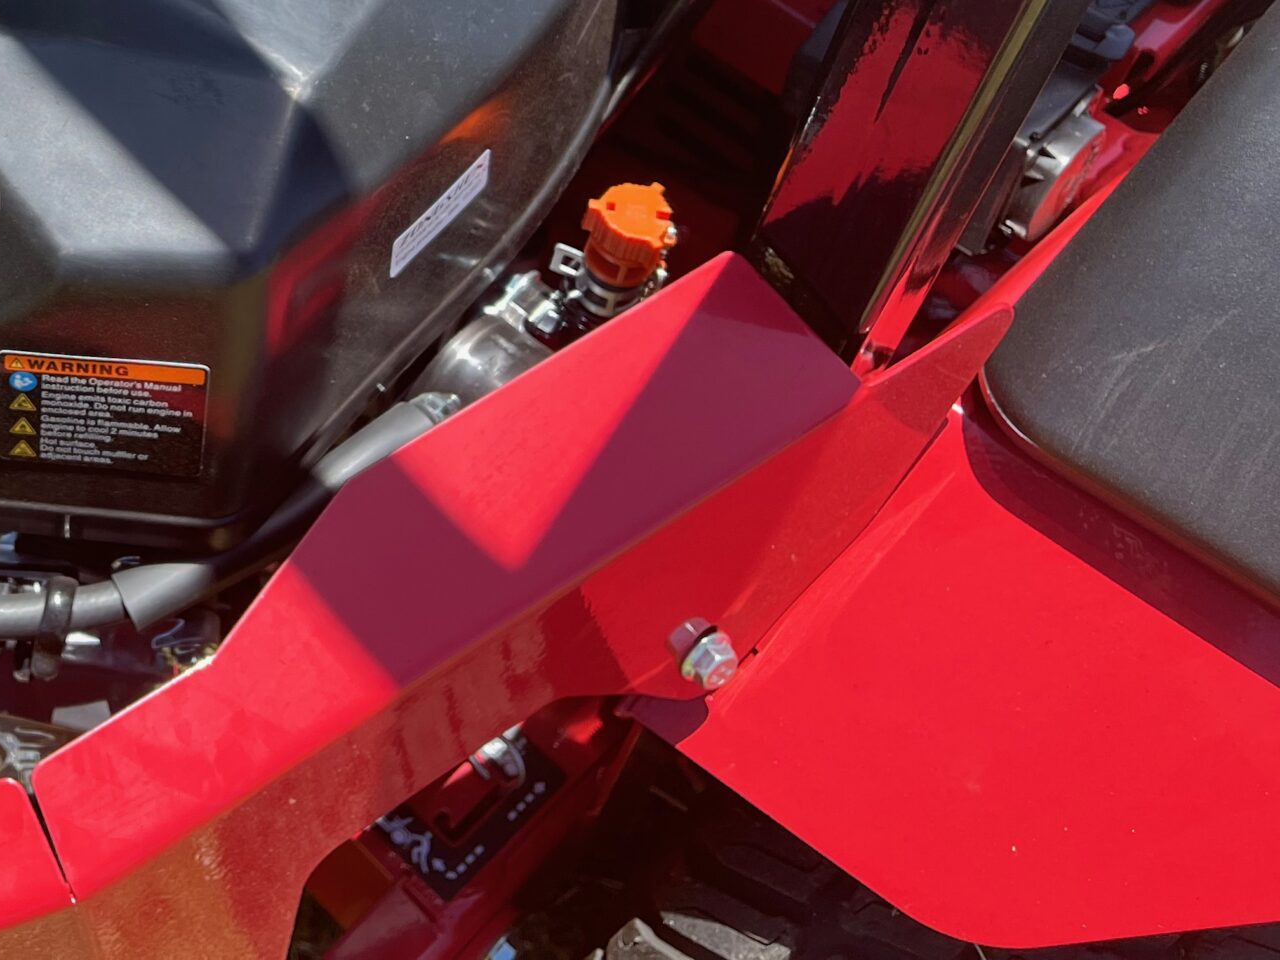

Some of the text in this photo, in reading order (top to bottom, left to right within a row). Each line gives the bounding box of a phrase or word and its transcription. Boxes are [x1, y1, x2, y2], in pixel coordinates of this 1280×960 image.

[28, 359, 129, 376] WARNING
[42, 375, 69, 383] Read
[89, 378, 142, 389] Operator's
[144, 383, 182, 392] Manual
[96, 387, 128, 395] before
[41, 391, 76, 400] Engine
[133, 399, 168, 407] carbon
[94, 402, 108, 410] Do
[110, 404, 126, 412] not
[147, 408, 182, 416] engine
[153, 424, 181, 433] Allow
